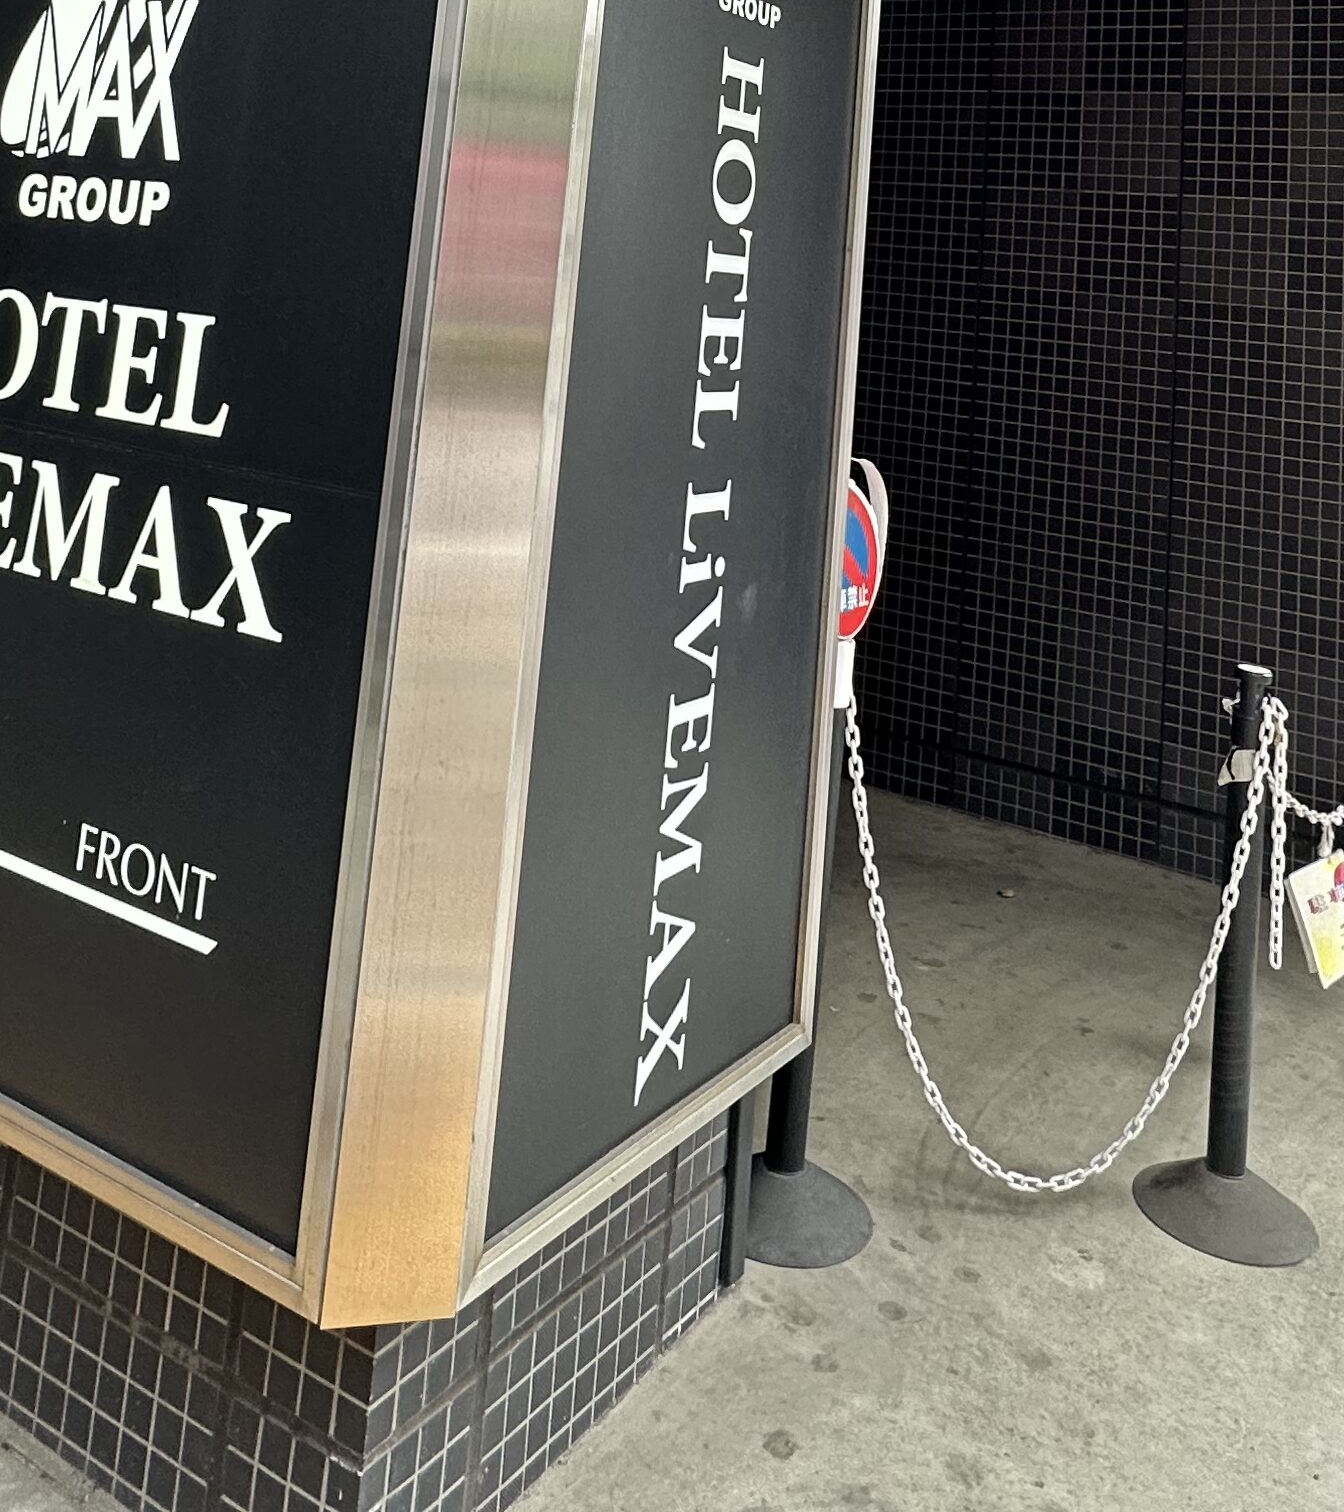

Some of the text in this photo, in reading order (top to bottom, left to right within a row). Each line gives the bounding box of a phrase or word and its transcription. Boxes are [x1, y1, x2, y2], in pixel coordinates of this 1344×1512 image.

[18, 173, 171, 226] GROUP
[633, 46, 765, 1108] HOTEL LiVEMAX
[74, 823, 217, 921] FRONT
